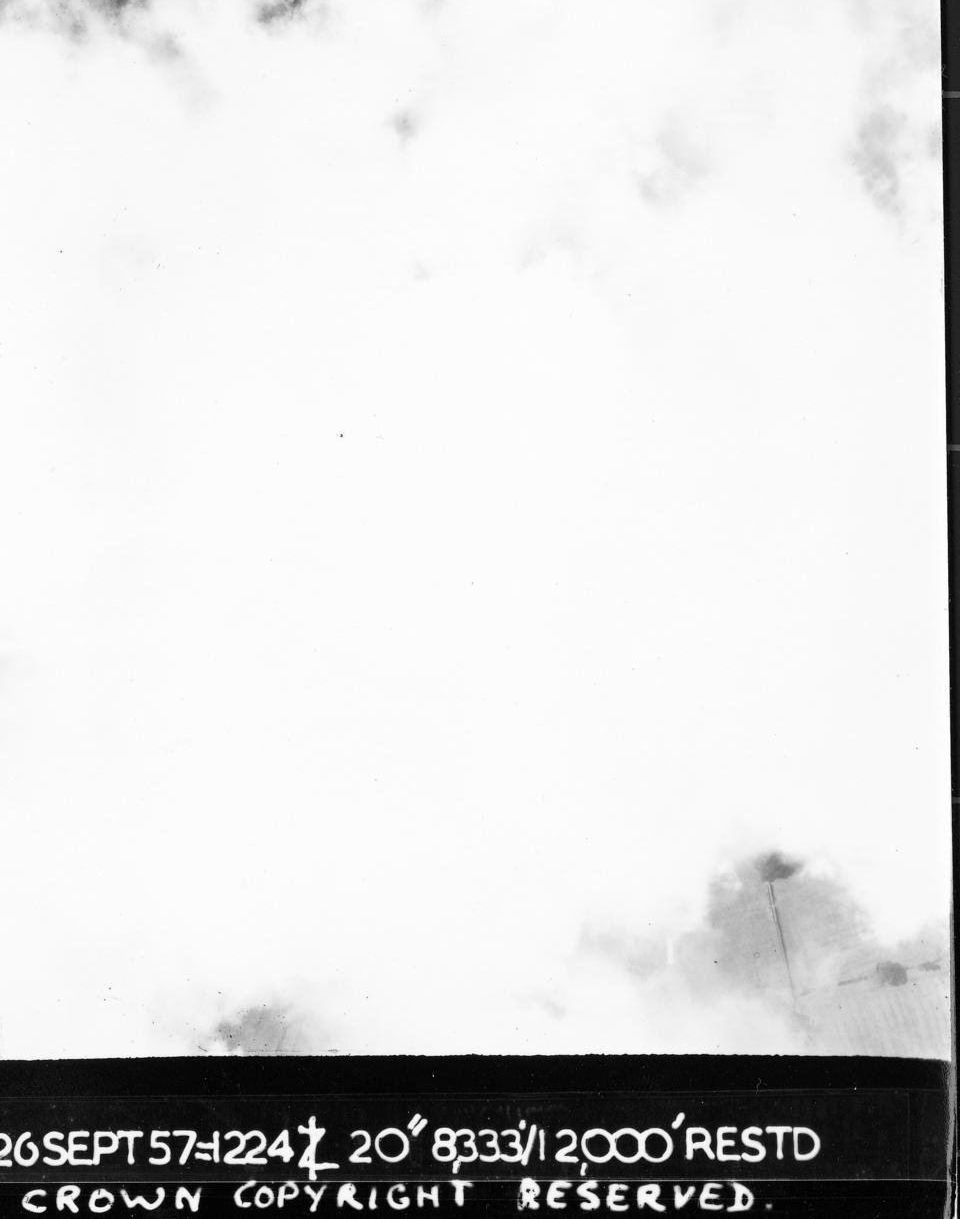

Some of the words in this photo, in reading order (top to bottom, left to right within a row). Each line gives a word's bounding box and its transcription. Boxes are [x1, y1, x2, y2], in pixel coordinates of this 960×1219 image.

[685, 1126, 821, 1162] RESTD
[20, 1183, 202, 1214] CROWN
[233, 1178, 474, 1213] COPYRIGHT
